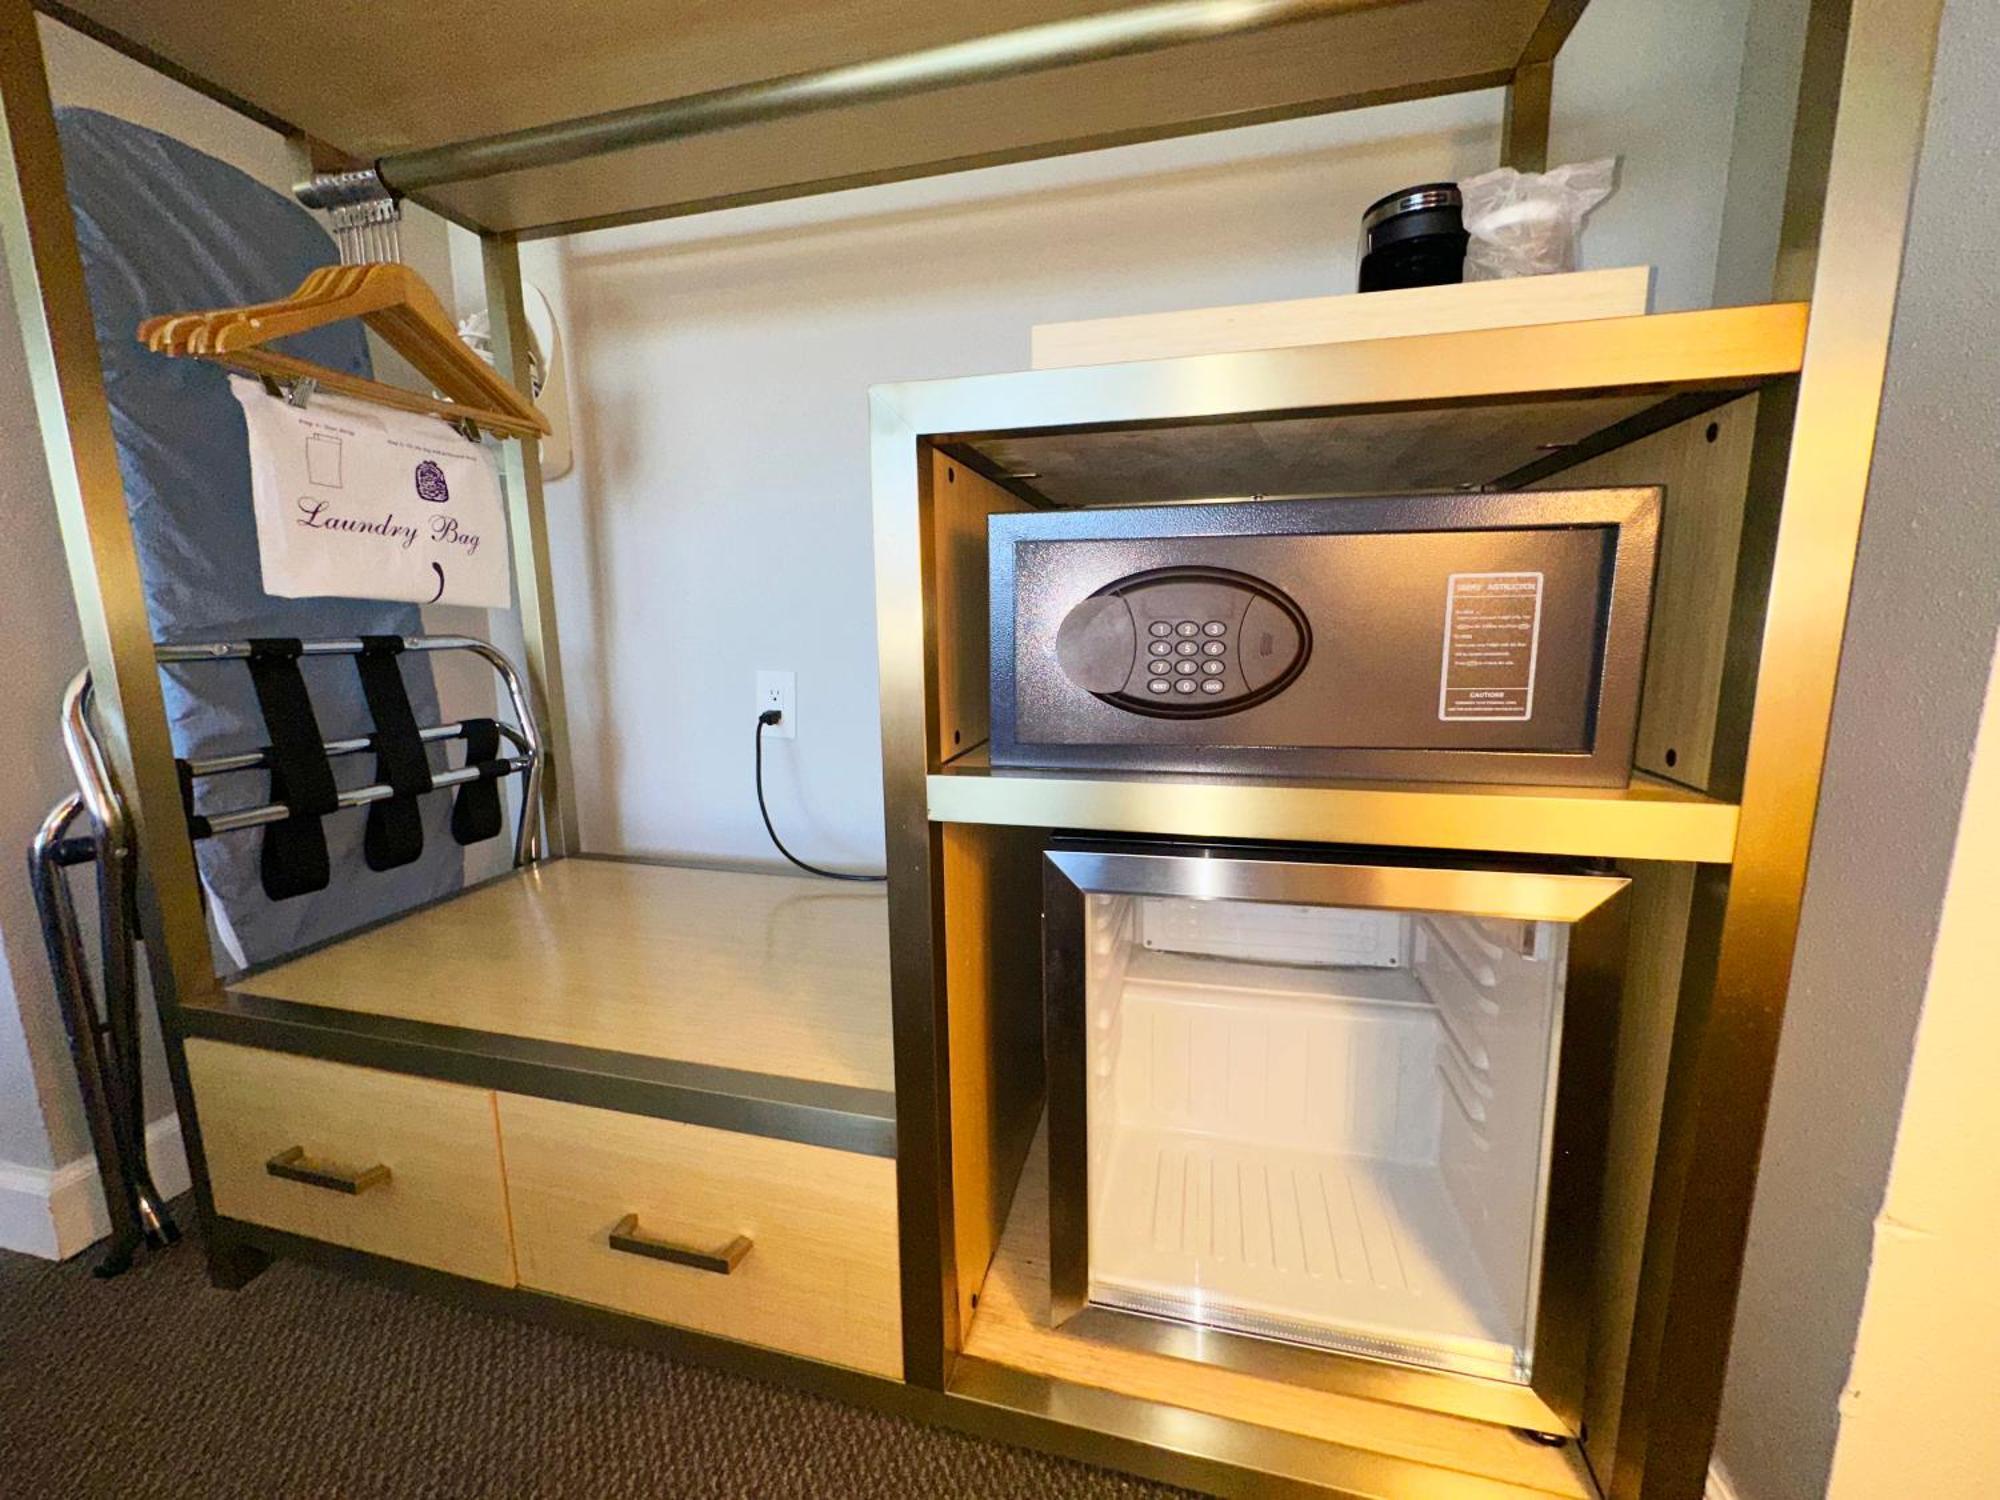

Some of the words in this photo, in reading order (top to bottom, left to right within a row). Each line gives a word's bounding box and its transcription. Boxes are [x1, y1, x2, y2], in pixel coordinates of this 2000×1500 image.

[296, 496, 418, 549] Laundry
[428, 514, 481, 556] Bag
[1184, 626, 1191, 634] 2
[1212, 625, 1218, 634] 3
[1157, 645, 1164, 653] 4
[1184, 644, 1191, 653] 5
[1211, 644, 1217, 653] 6
[1158, 663, 1163, 672] 7
[1184, 663, 1190, 672] 8
[1211, 663, 1217, 671] 9
[1183, 682, 1190, 691] 0
